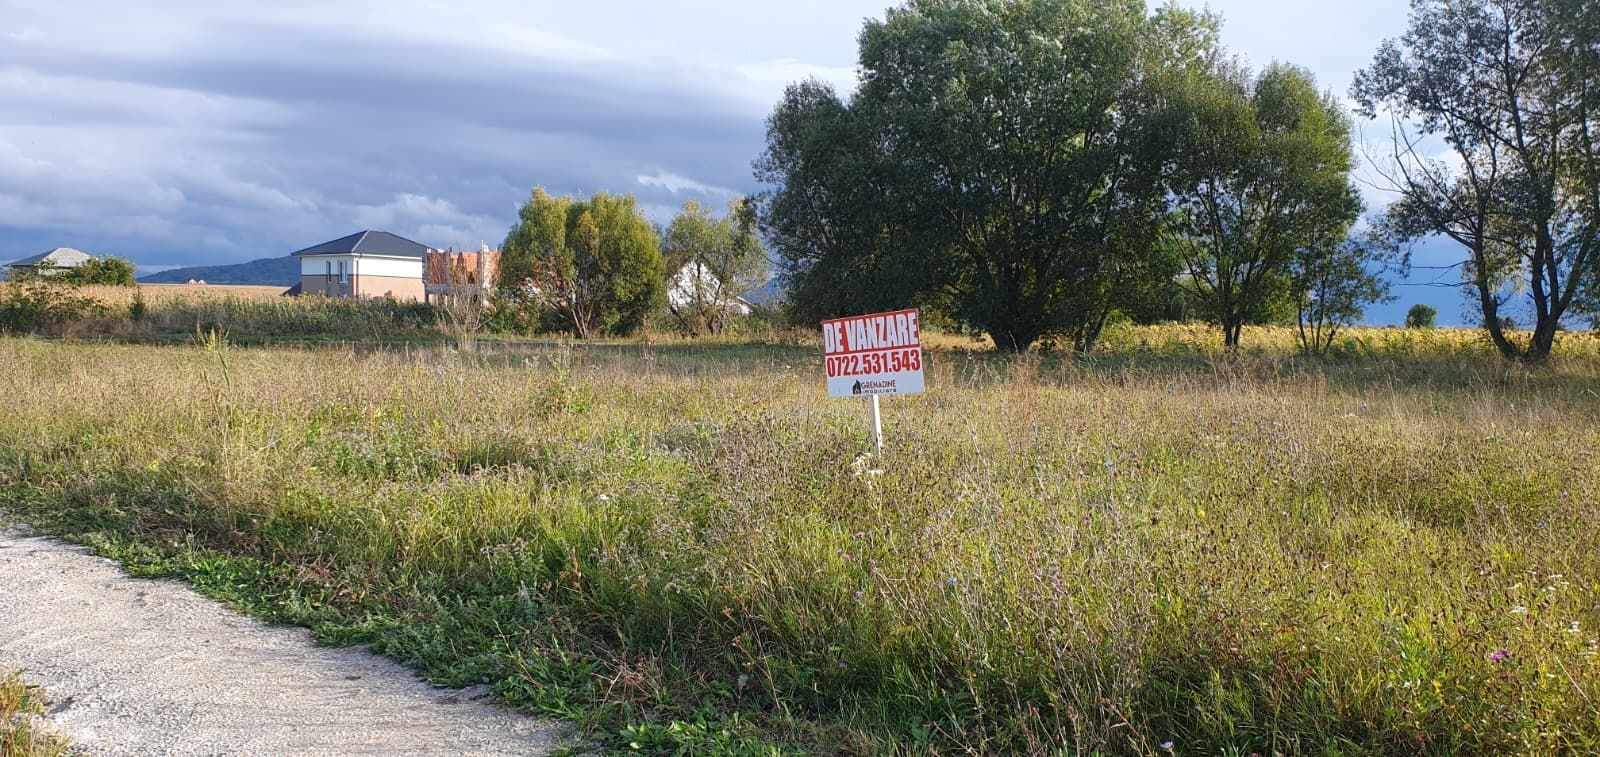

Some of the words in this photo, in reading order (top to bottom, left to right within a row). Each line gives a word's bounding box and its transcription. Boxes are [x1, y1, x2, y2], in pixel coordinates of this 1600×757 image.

[823, 322, 844, 353] DE
[844, 312, 919, 351] VANZARE
[827, 349, 920, 377] 0722.531.543
[861, 380, 896, 389] GRENADINE
